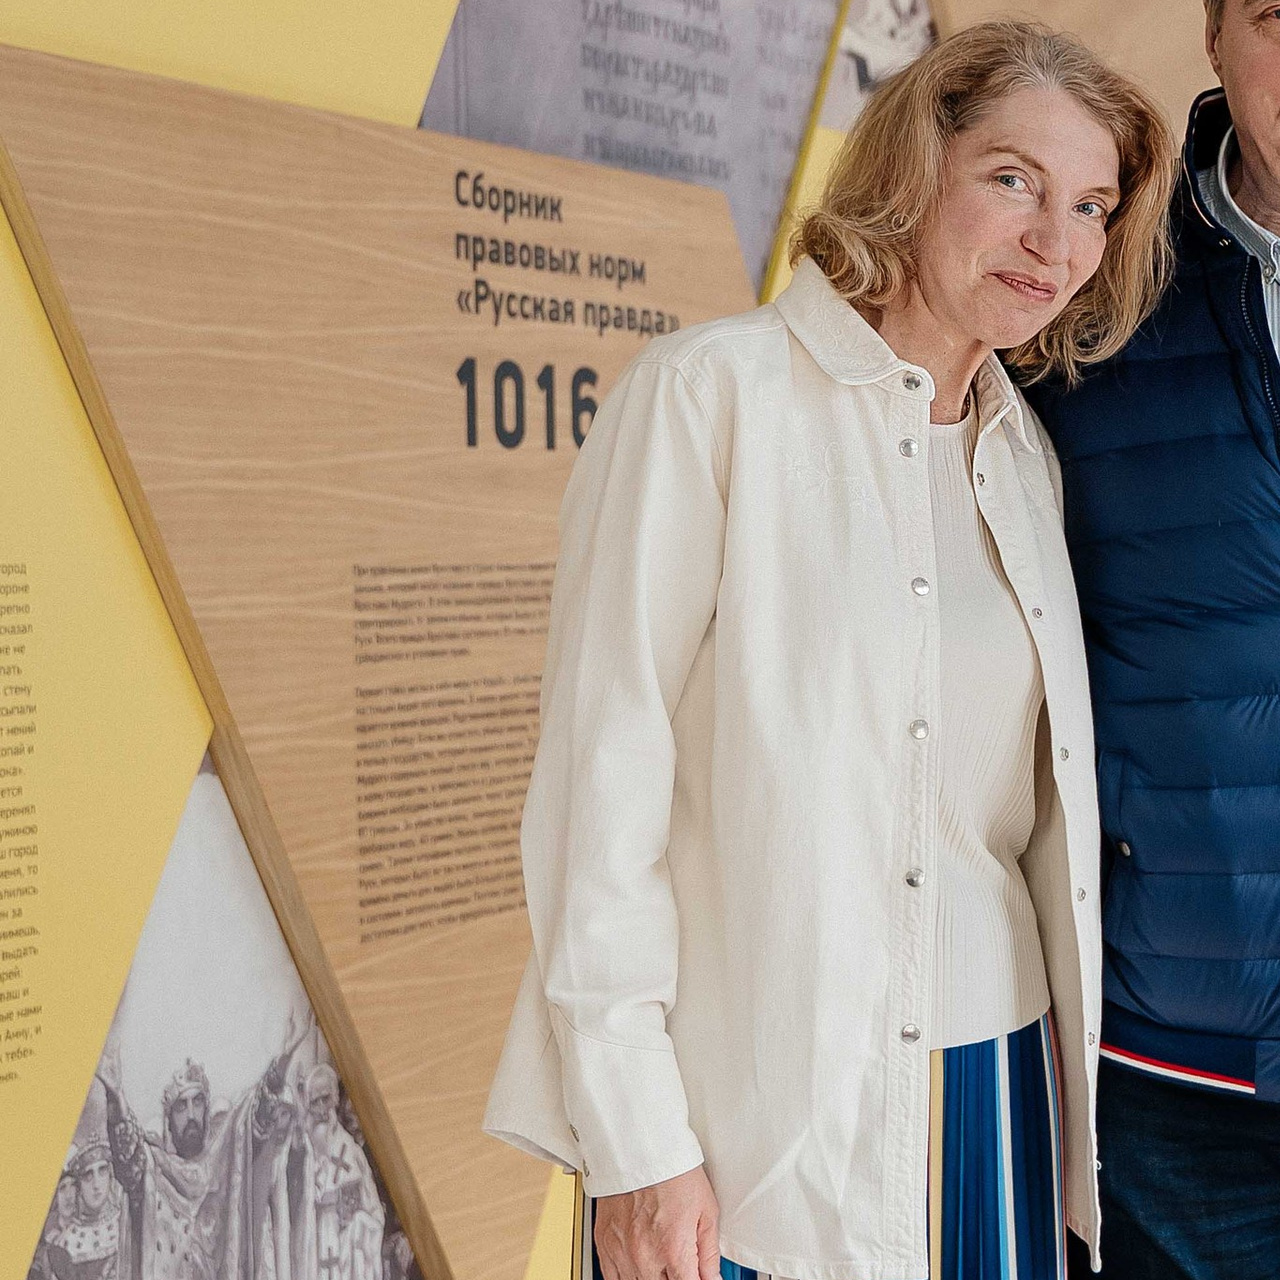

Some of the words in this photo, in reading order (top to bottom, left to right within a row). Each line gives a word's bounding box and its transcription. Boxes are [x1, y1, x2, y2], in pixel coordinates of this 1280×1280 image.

[455, 171, 563, 223] Сборник
[455, 233, 581, 271] правовых
[588, 254, 646, 289] норм
[457, 279, 576, 326] «Русская
[584, 300, 680, 337] правда»
[456, 356, 599, 451] 1016
